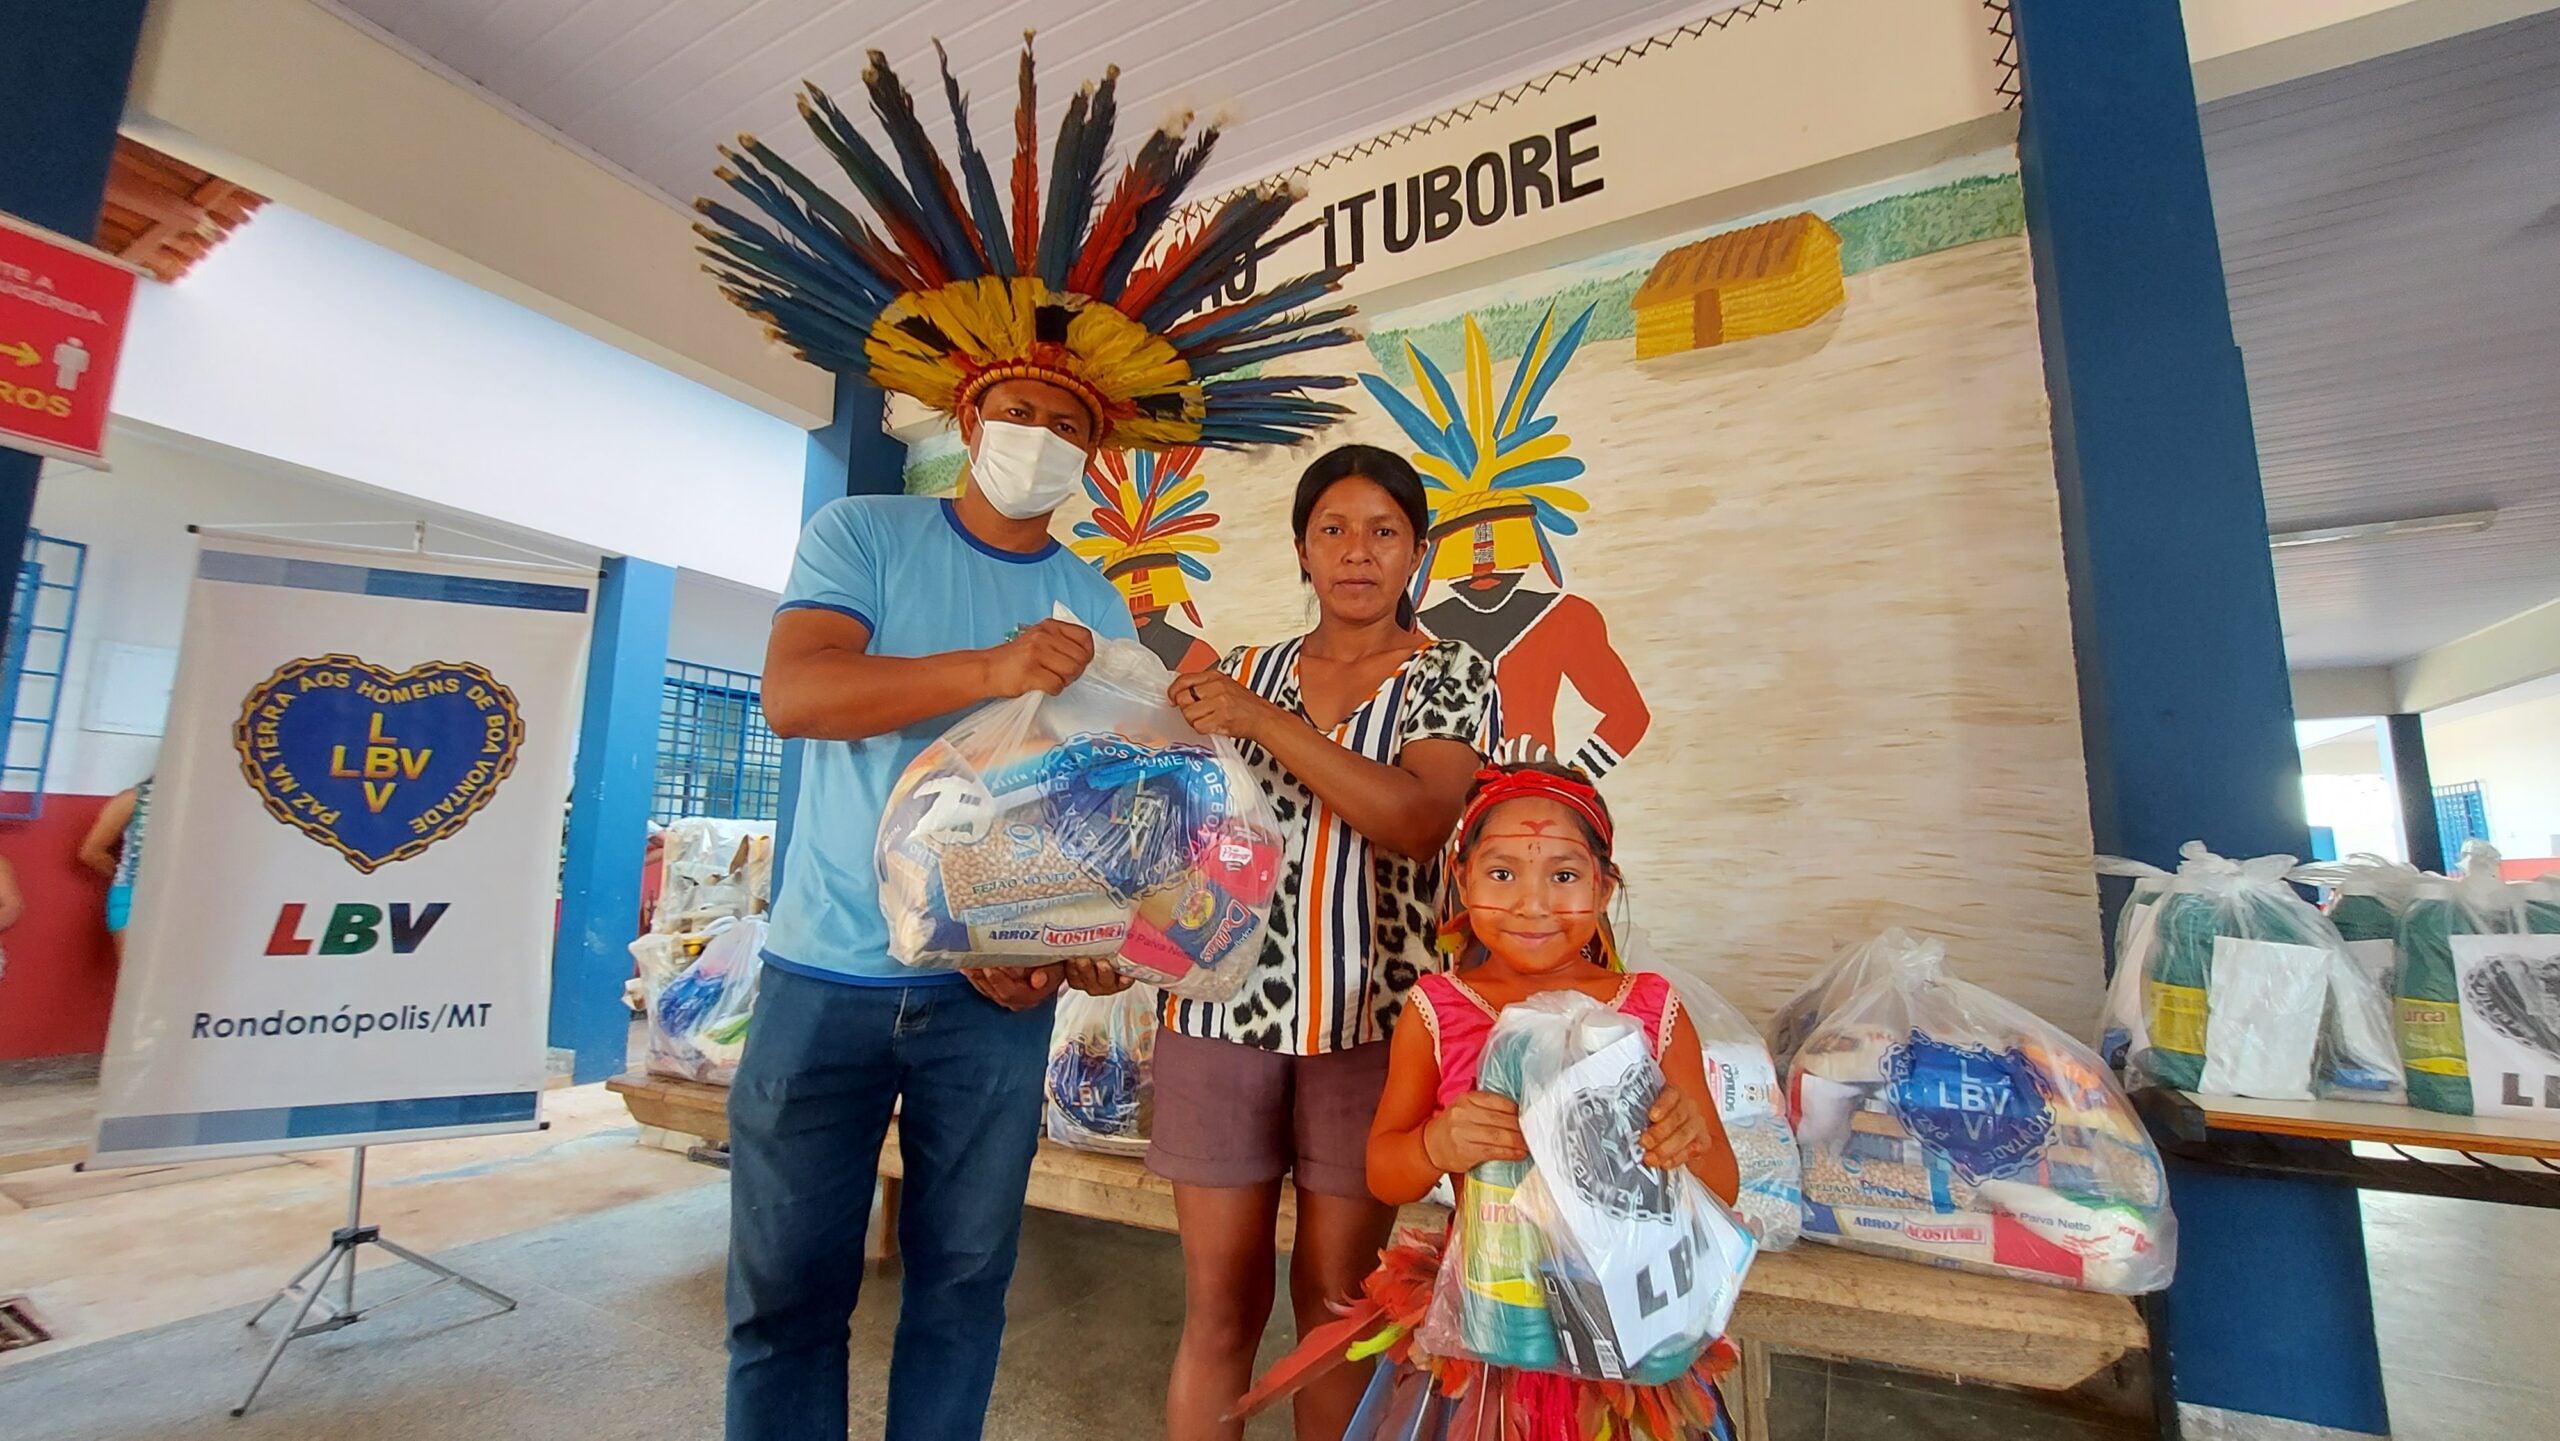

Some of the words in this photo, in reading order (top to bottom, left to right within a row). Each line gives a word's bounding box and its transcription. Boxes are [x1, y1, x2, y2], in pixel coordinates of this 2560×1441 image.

[1323, 115, 1604, 272] ITUBORE
[300, 671, 351, 692] AOS
[356, 677, 460, 704] HOMENS
[465, 685, 496, 710] DE
[257, 691, 297, 762] TERRA
[481, 714, 505, 754] BOA
[268, 763, 300, 793] NA
[330, 745, 433, 780] LBV
[1091, 745, 1129, 759] AOS
[1203, 772, 1223, 796] DE
[291, 792, 341, 825] PAZ
[409, 760, 495, 834] VONTADE
[264, 902, 451, 956] LBV
[988, 929, 1041, 941] ARROZ
[1200, 898, 1252, 962] Dallas
[192, 1003, 491, 1039] Rondonópolis/MT
[1939, 1081, 2012, 1116] LBV
[1916, 1114, 1950, 1140] PAZ
[1853, 1217, 1900, 1231] ARROZ
[2020, 1212, 2054, 1226] Paiva
[2058, 1218, 2092, 1232] Netto
